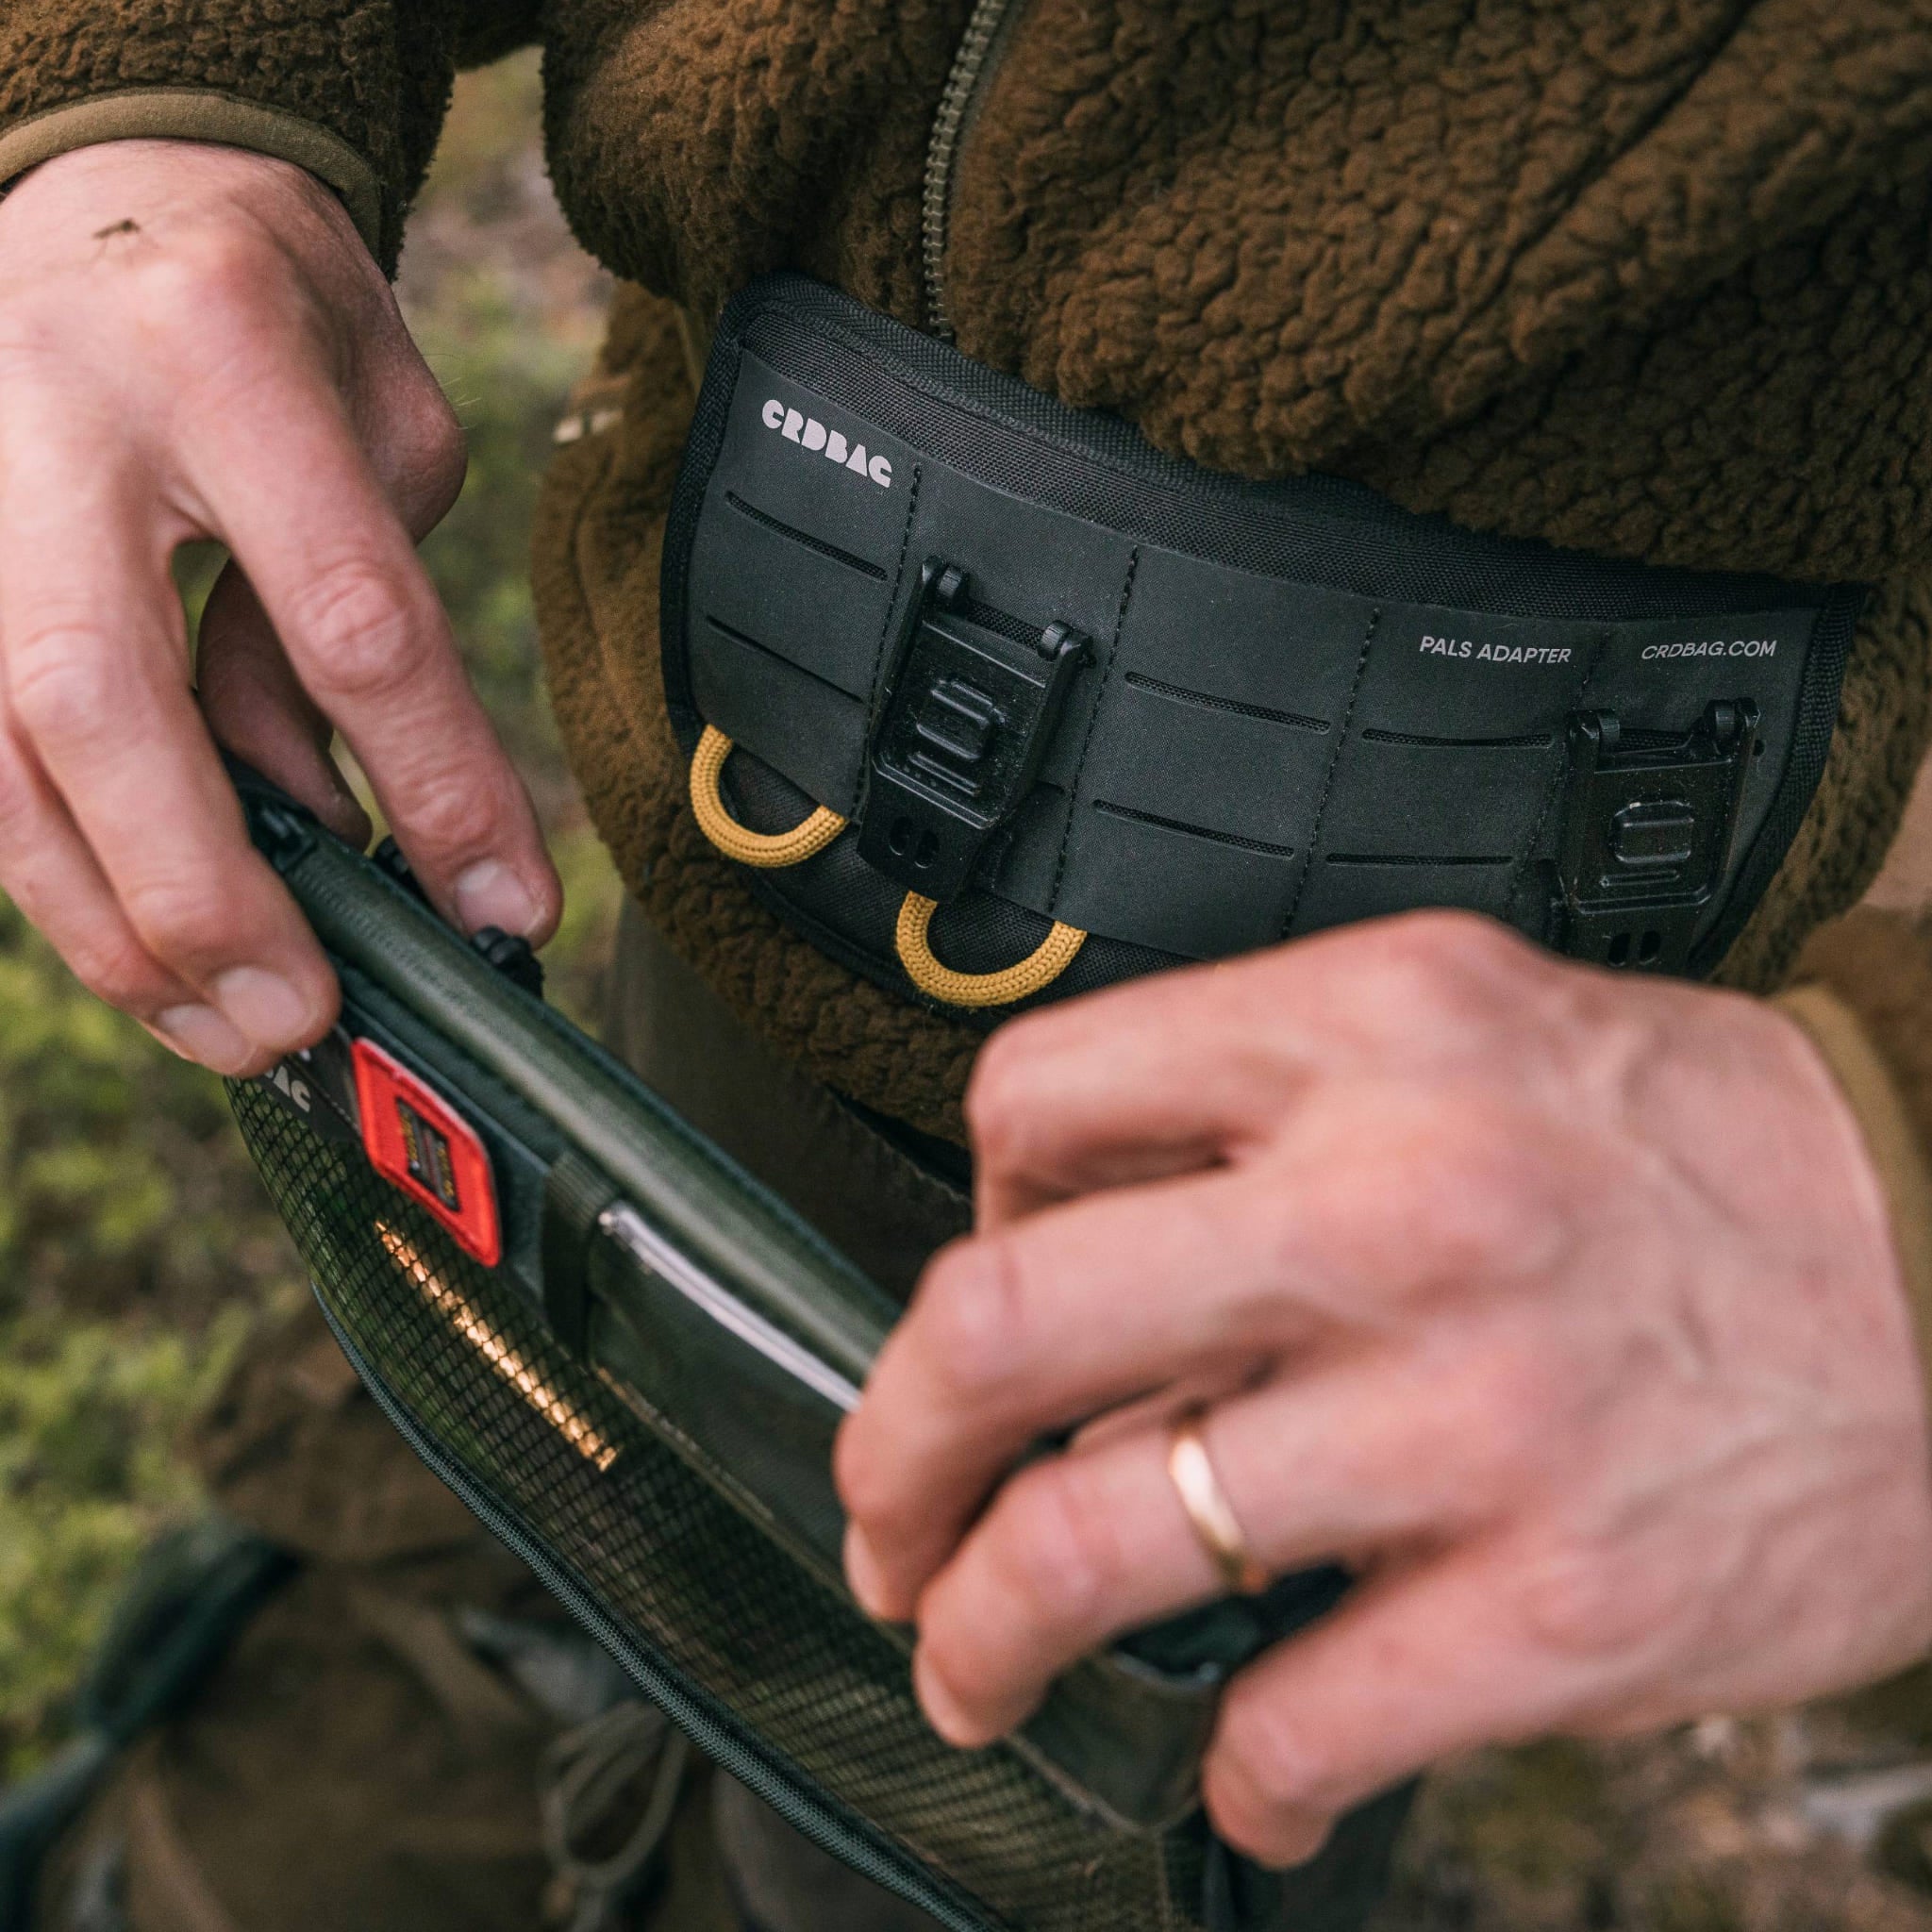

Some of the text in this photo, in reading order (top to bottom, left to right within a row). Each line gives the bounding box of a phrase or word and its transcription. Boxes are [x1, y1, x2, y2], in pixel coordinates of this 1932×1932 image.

[1419, 635, 1572, 664] PALS ADAPTER
[1641, 640, 1777, 659] CRDBAG.COM
